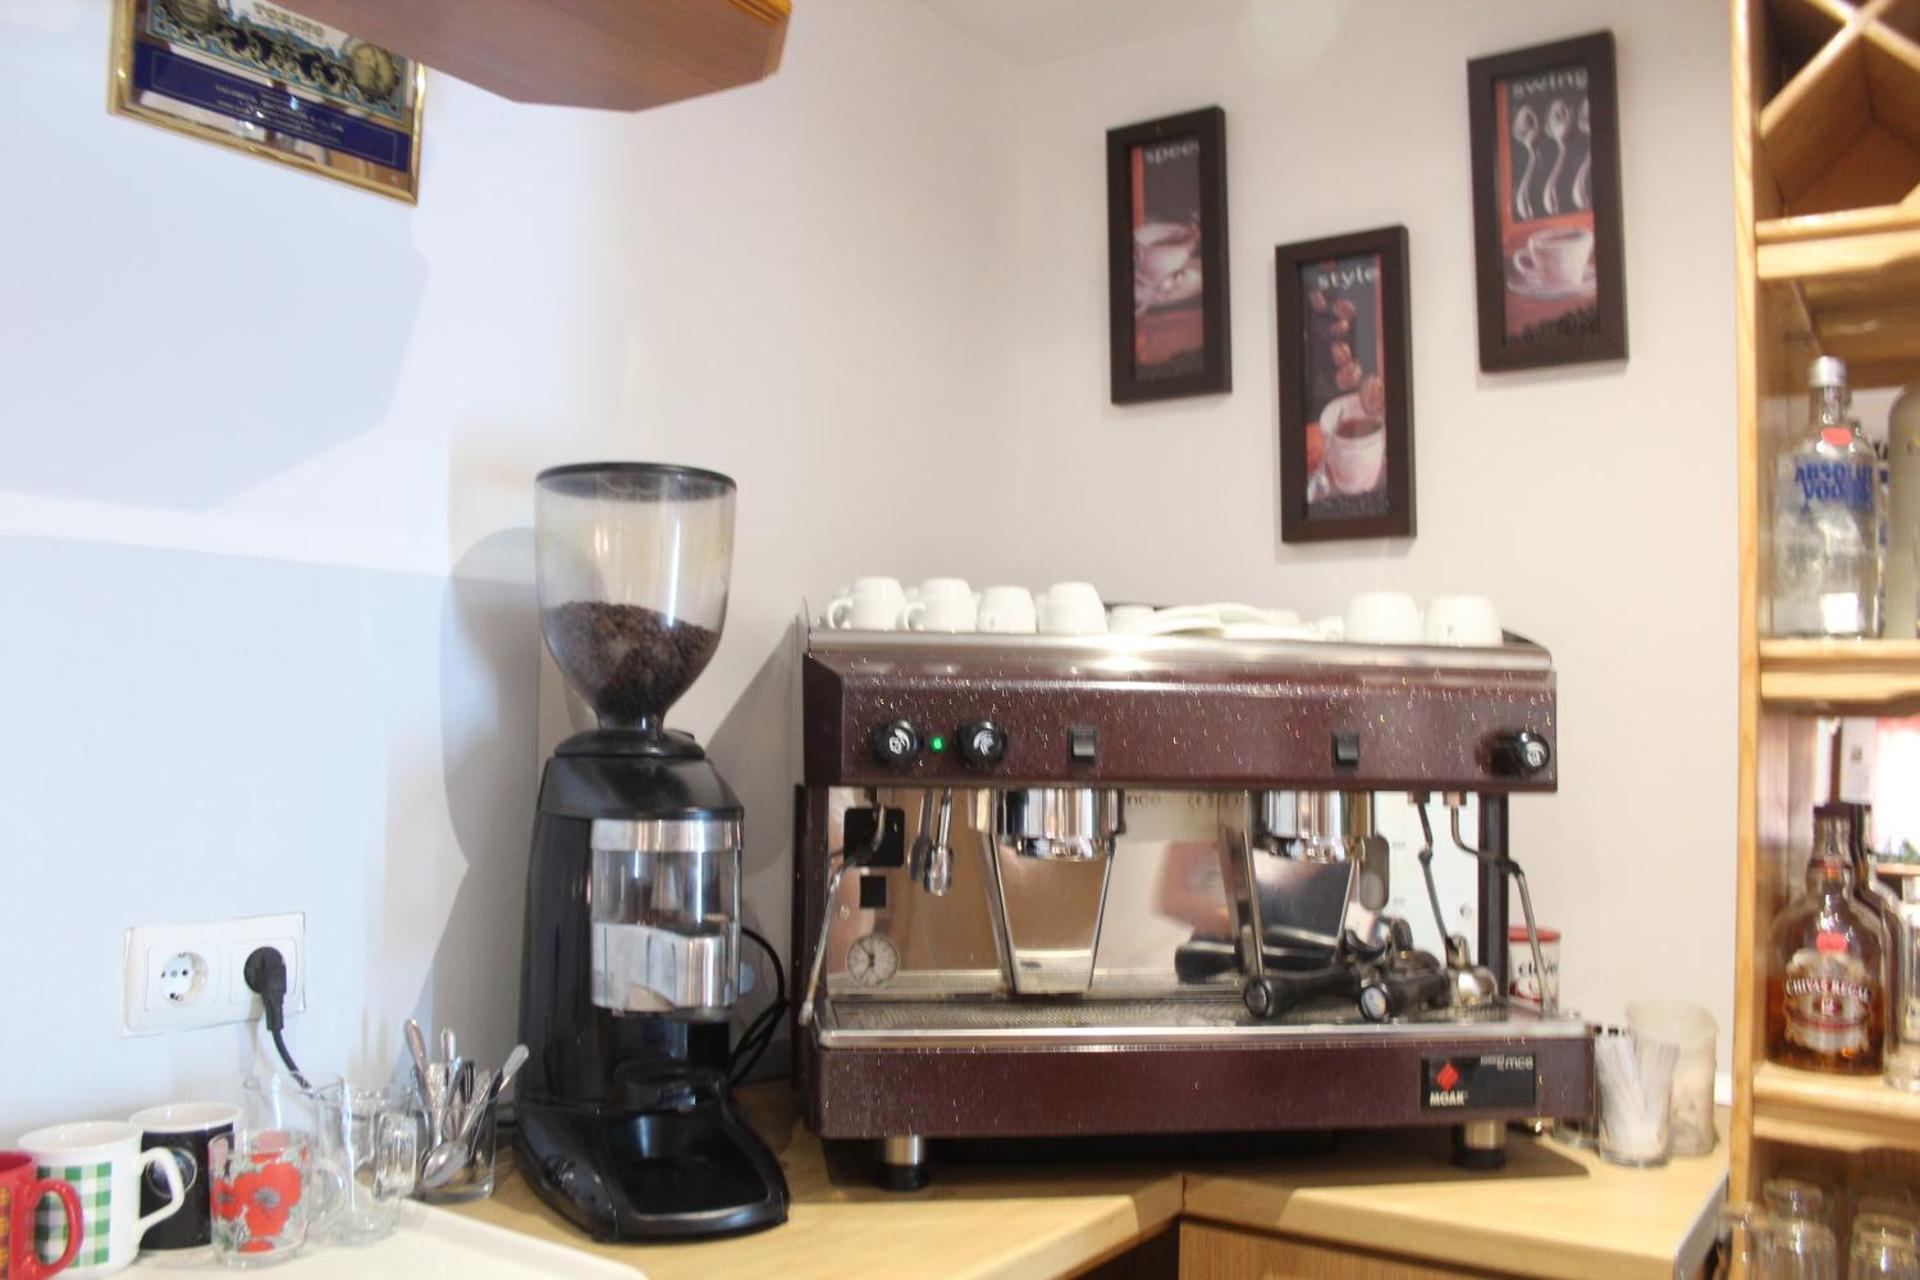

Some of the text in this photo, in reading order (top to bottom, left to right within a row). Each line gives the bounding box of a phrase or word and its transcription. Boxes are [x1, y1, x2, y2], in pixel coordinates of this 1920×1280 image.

[1512, 69, 1588, 98] swing
[1318, 265, 1380, 290] style
[1785, 978, 1827, 996] CHIVAS
[1429, 1090, 1465, 1106] MOAK
